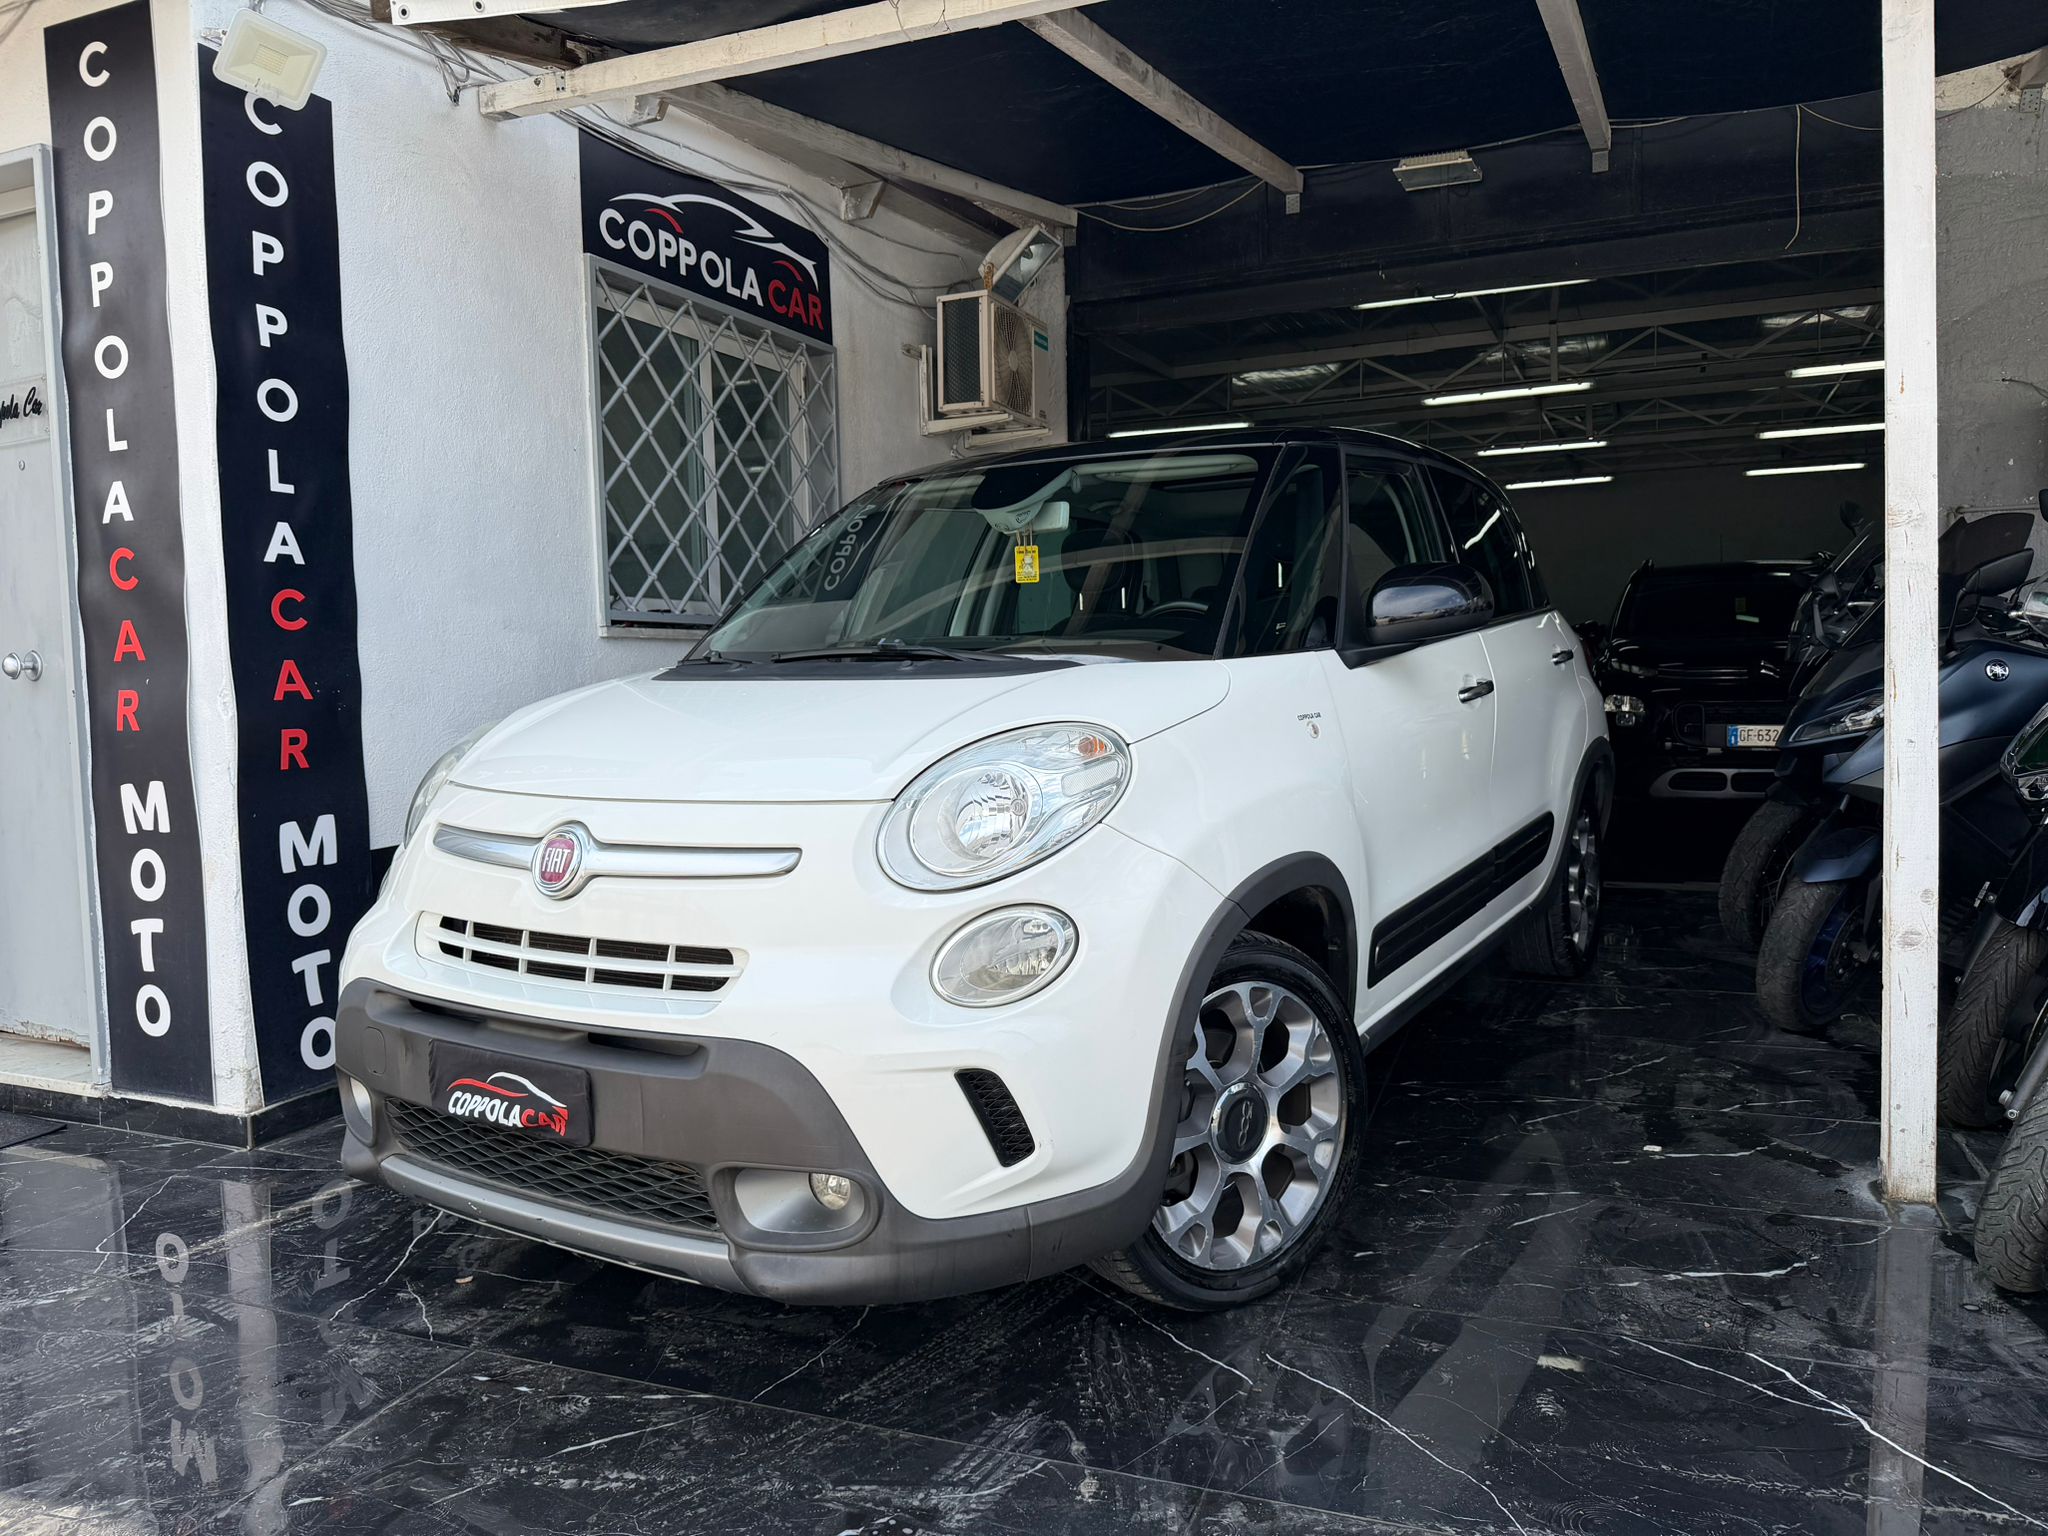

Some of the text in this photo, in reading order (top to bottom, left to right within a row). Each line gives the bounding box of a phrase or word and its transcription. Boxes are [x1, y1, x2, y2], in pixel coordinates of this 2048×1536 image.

[120, 780, 172, 1037] MOTO
[279, 814, 337, 1071] MOTO
[542, 847, 571, 873] FIAT
